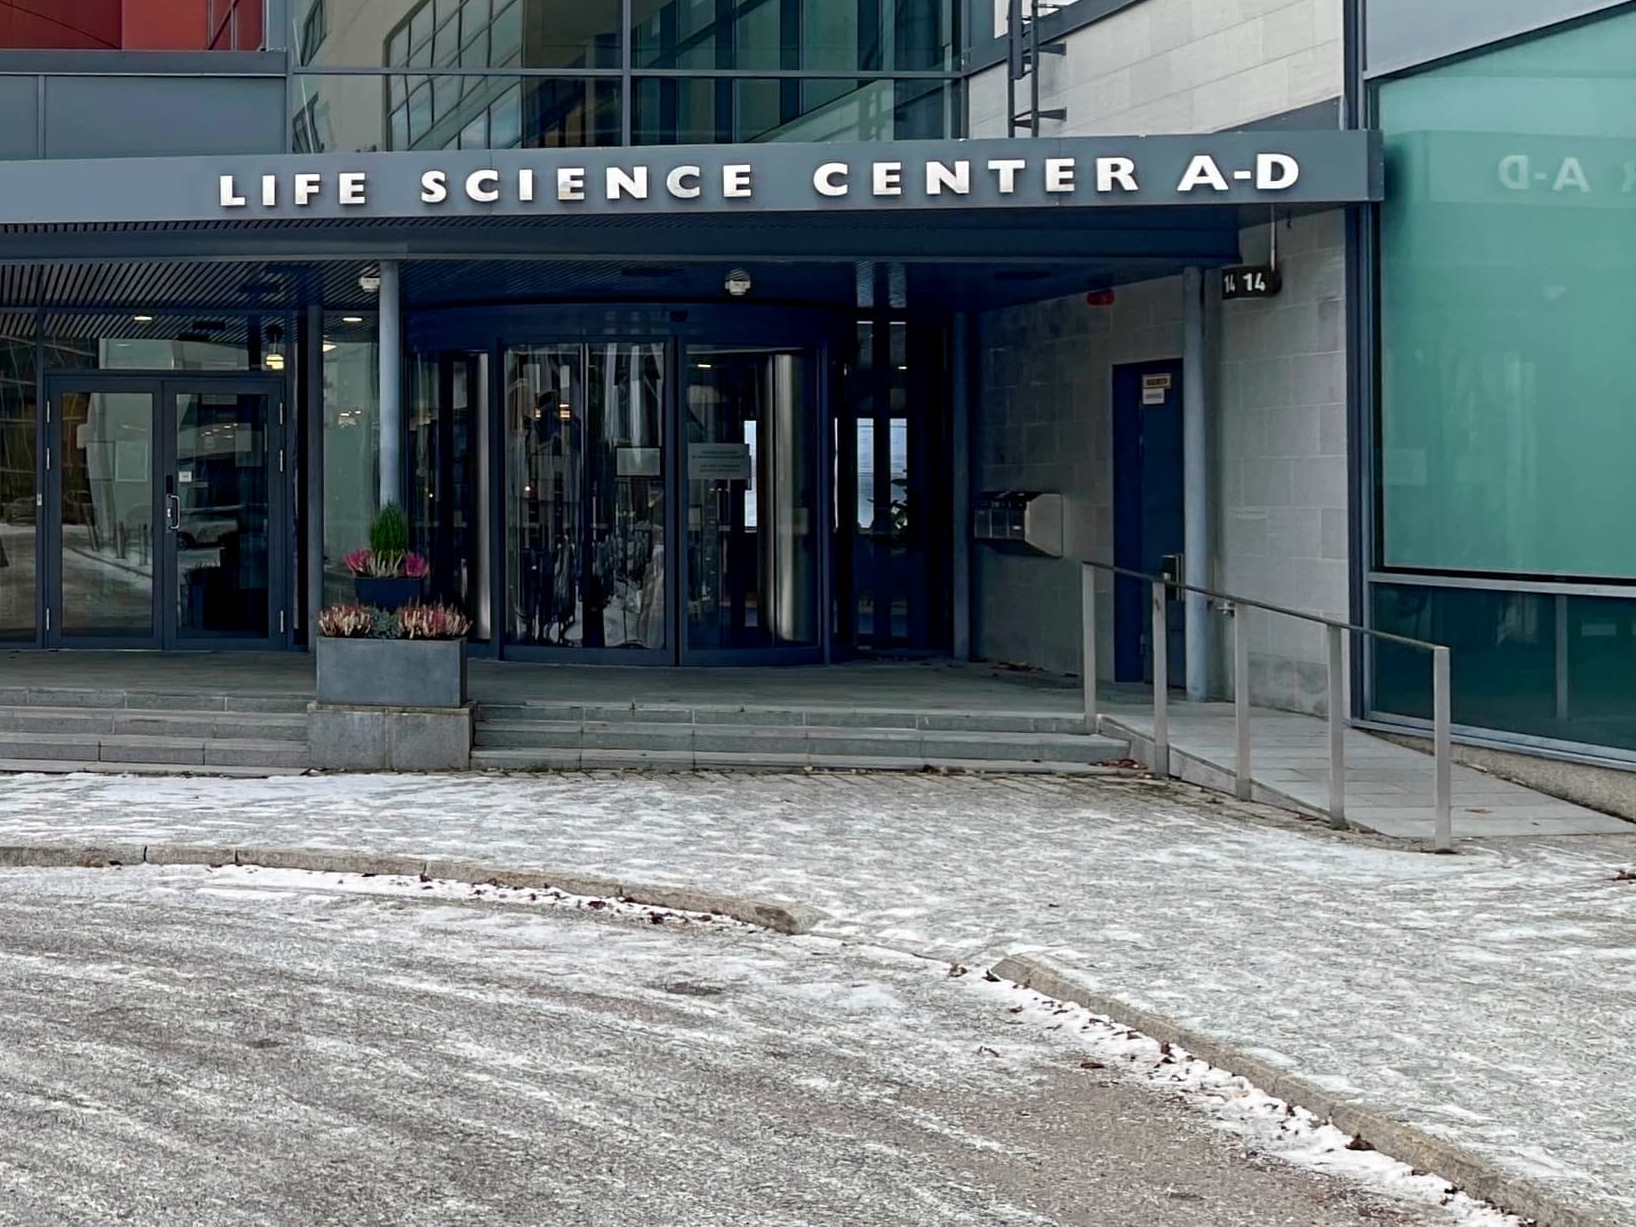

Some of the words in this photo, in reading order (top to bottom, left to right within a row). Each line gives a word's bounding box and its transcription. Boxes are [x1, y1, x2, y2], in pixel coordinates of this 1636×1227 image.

[219, 172, 366, 206] LIFE
[420, 164, 752, 203] SCIENCE
[813, 157, 1139, 196] CENTER
[1176, 153, 1299, 192] A-D
[1243, 272, 1266, 291] 14
